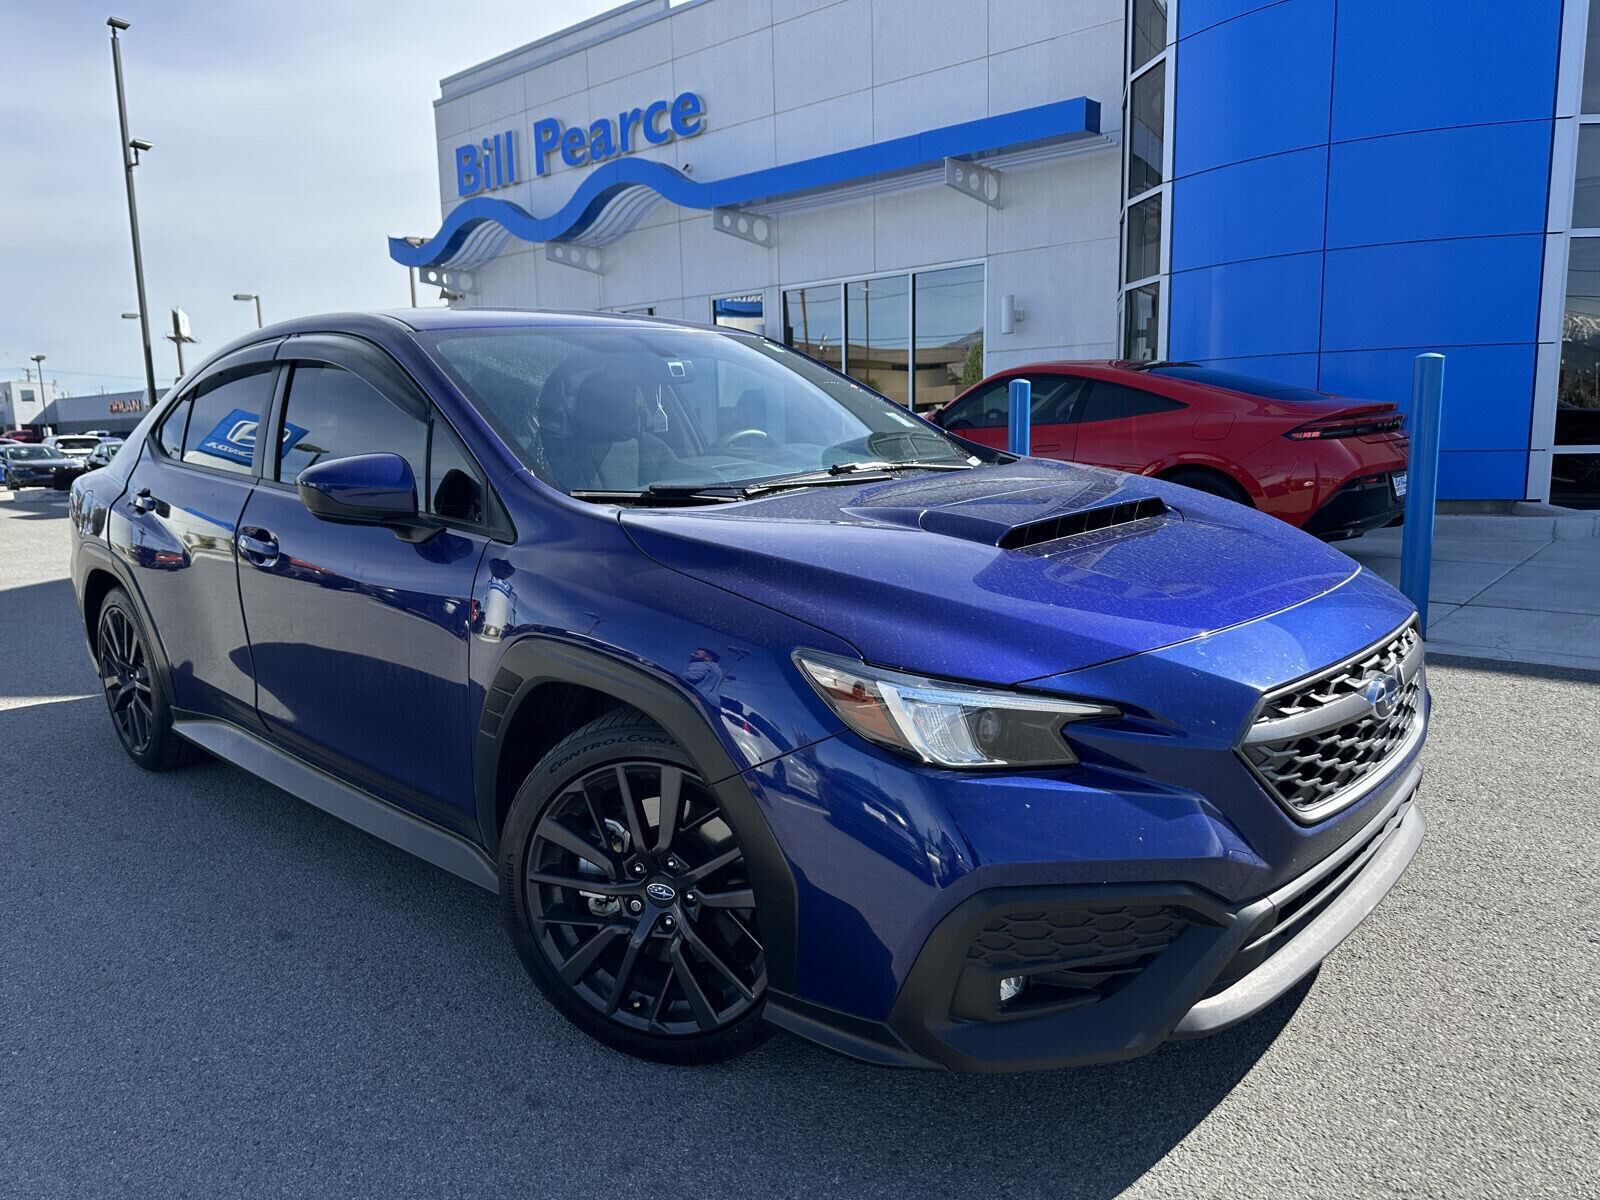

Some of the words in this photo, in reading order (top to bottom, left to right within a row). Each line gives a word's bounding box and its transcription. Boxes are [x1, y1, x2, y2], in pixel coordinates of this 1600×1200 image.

[456, 130, 516, 197] Bill
[533, 91, 704, 176] Pearce
[550, 734, 680, 773] CONTROLCONT
